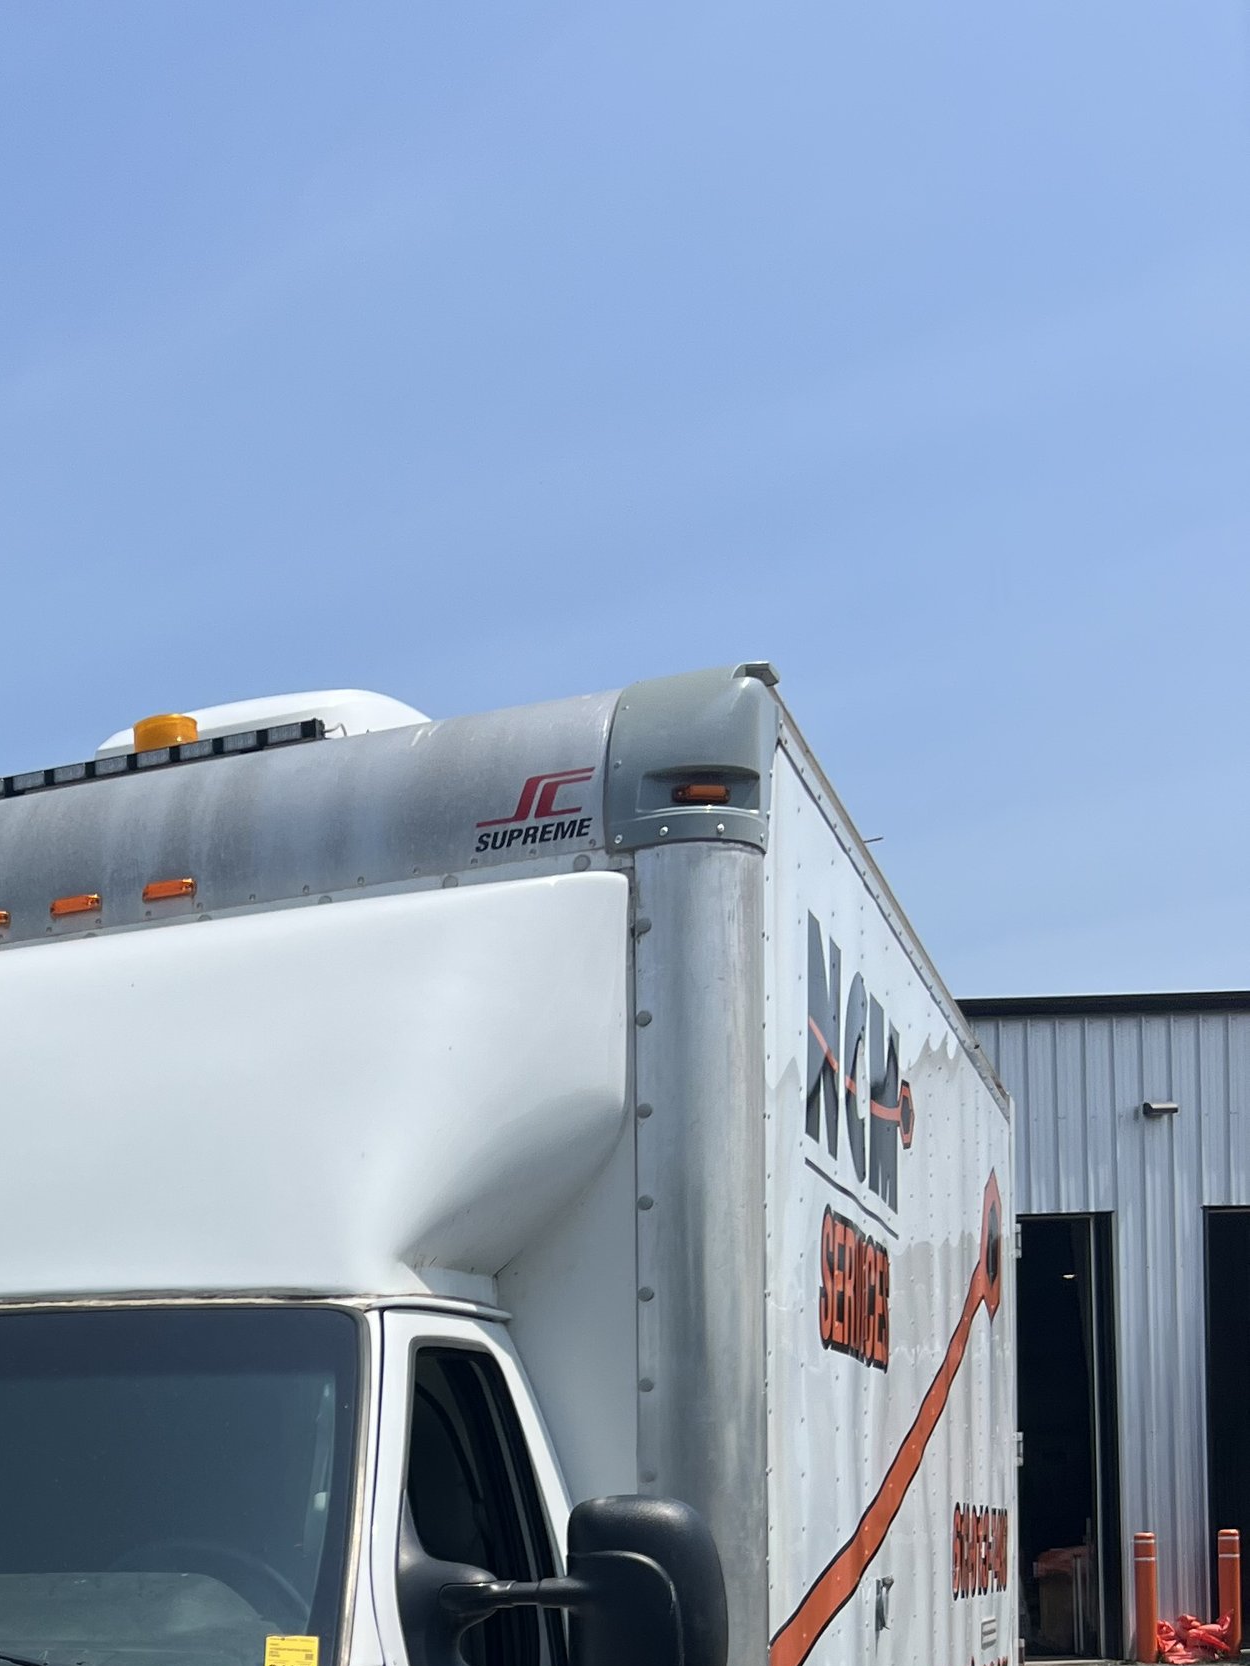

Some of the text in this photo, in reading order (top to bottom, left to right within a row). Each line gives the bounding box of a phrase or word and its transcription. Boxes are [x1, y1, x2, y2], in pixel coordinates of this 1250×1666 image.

[475, 817, 593, 852] SUPREME
[805, 909, 899, 1214] NCM
[820, 1204, 890, 1374] SERVICES
